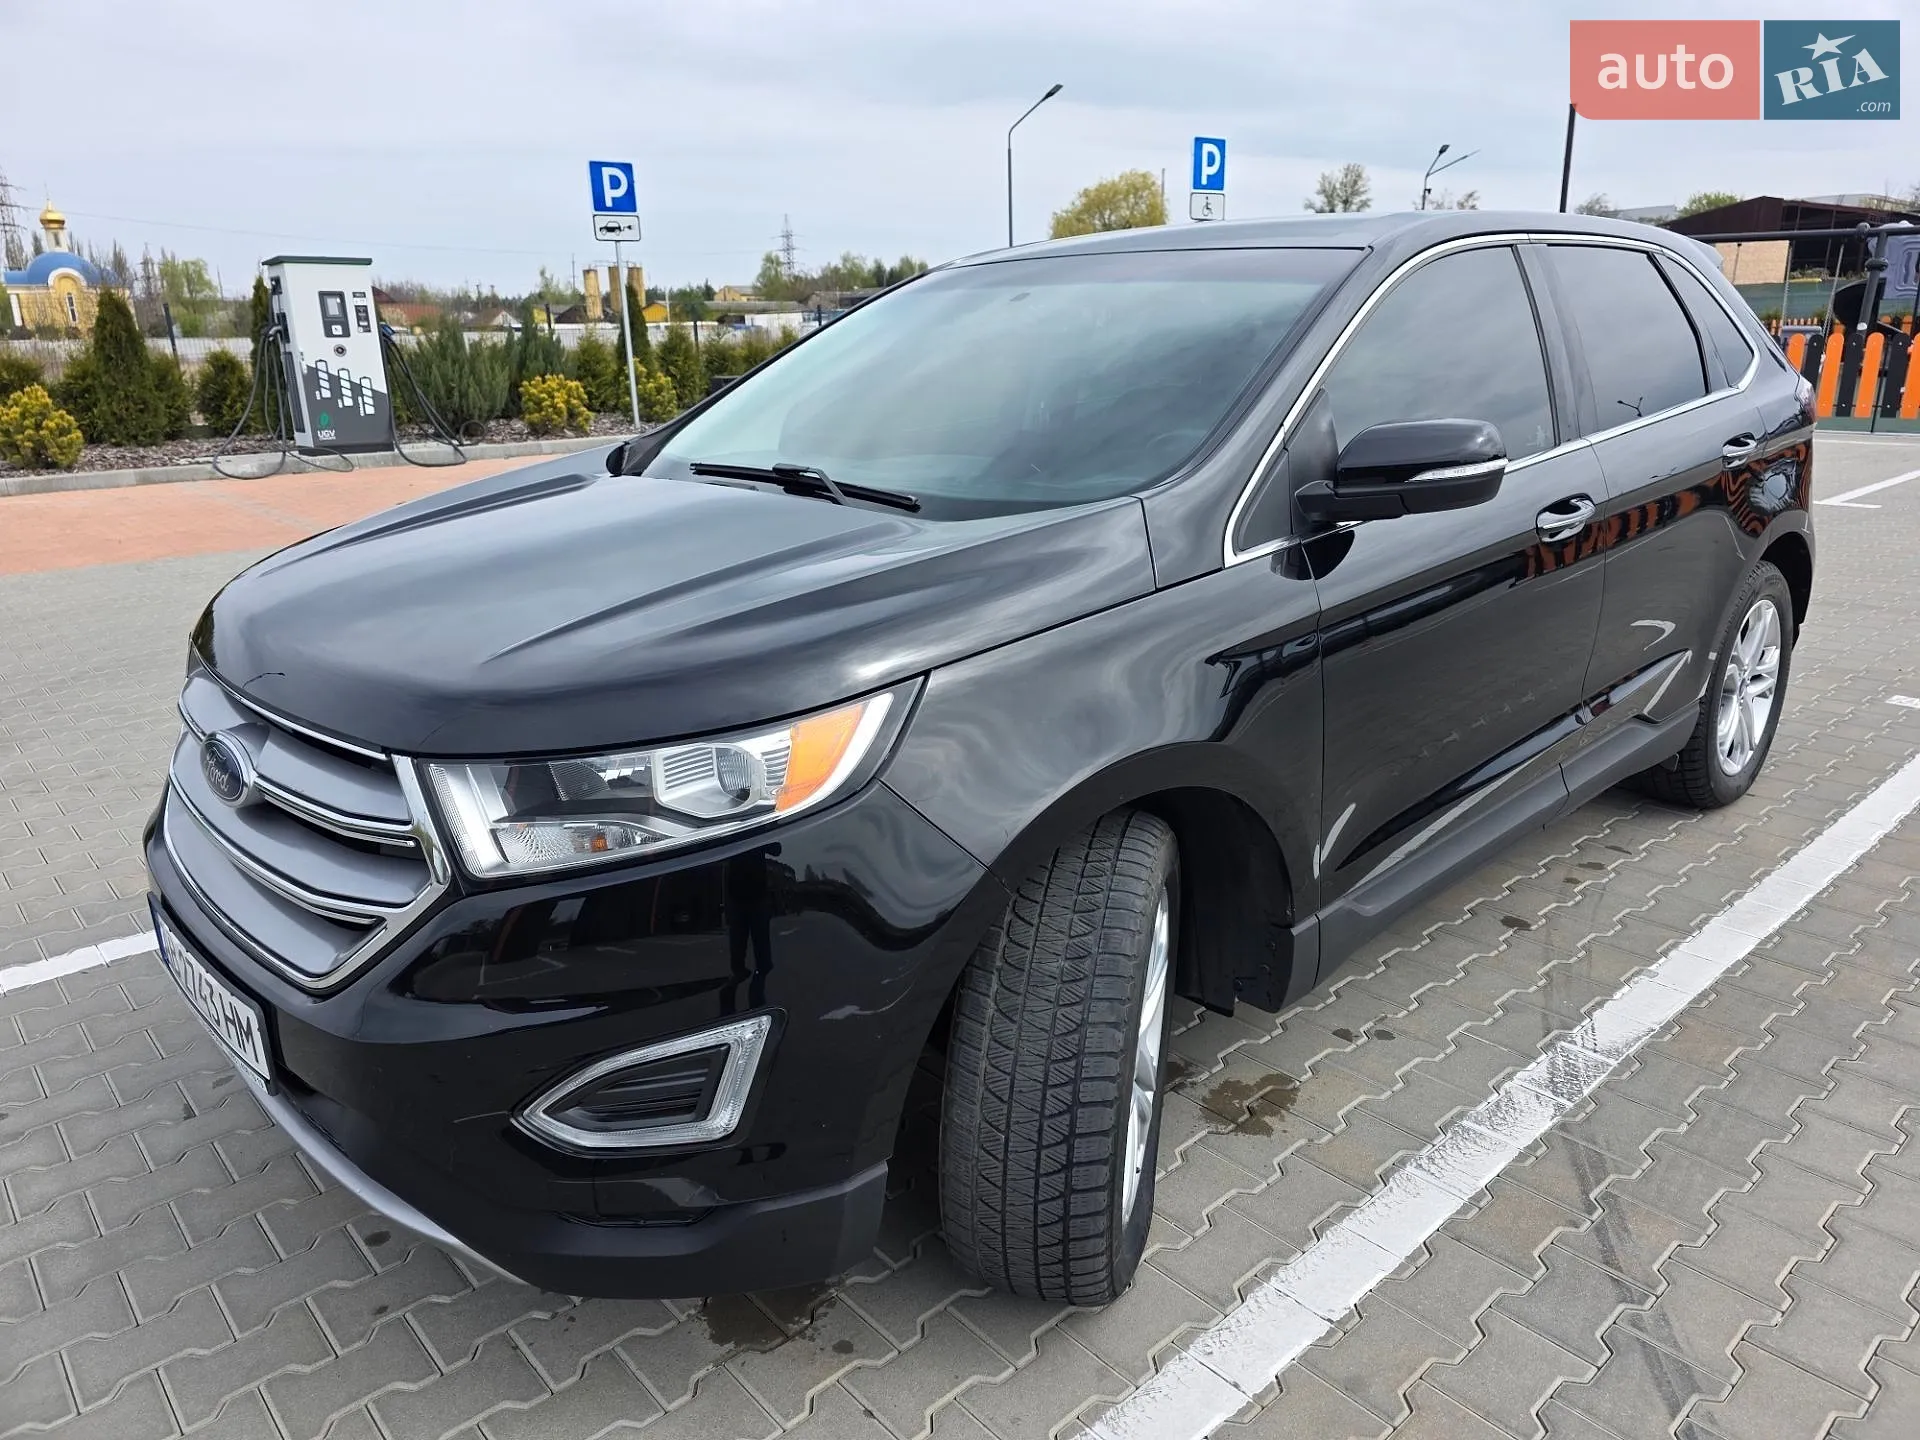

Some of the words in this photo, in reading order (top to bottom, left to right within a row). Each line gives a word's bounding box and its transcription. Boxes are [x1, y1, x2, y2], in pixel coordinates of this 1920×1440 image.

[1201, 143, 1221, 186] P
[601, 166, 628, 208] P
[317, 429, 335, 438] UGV
[205, 746, 231, 792] Ford
